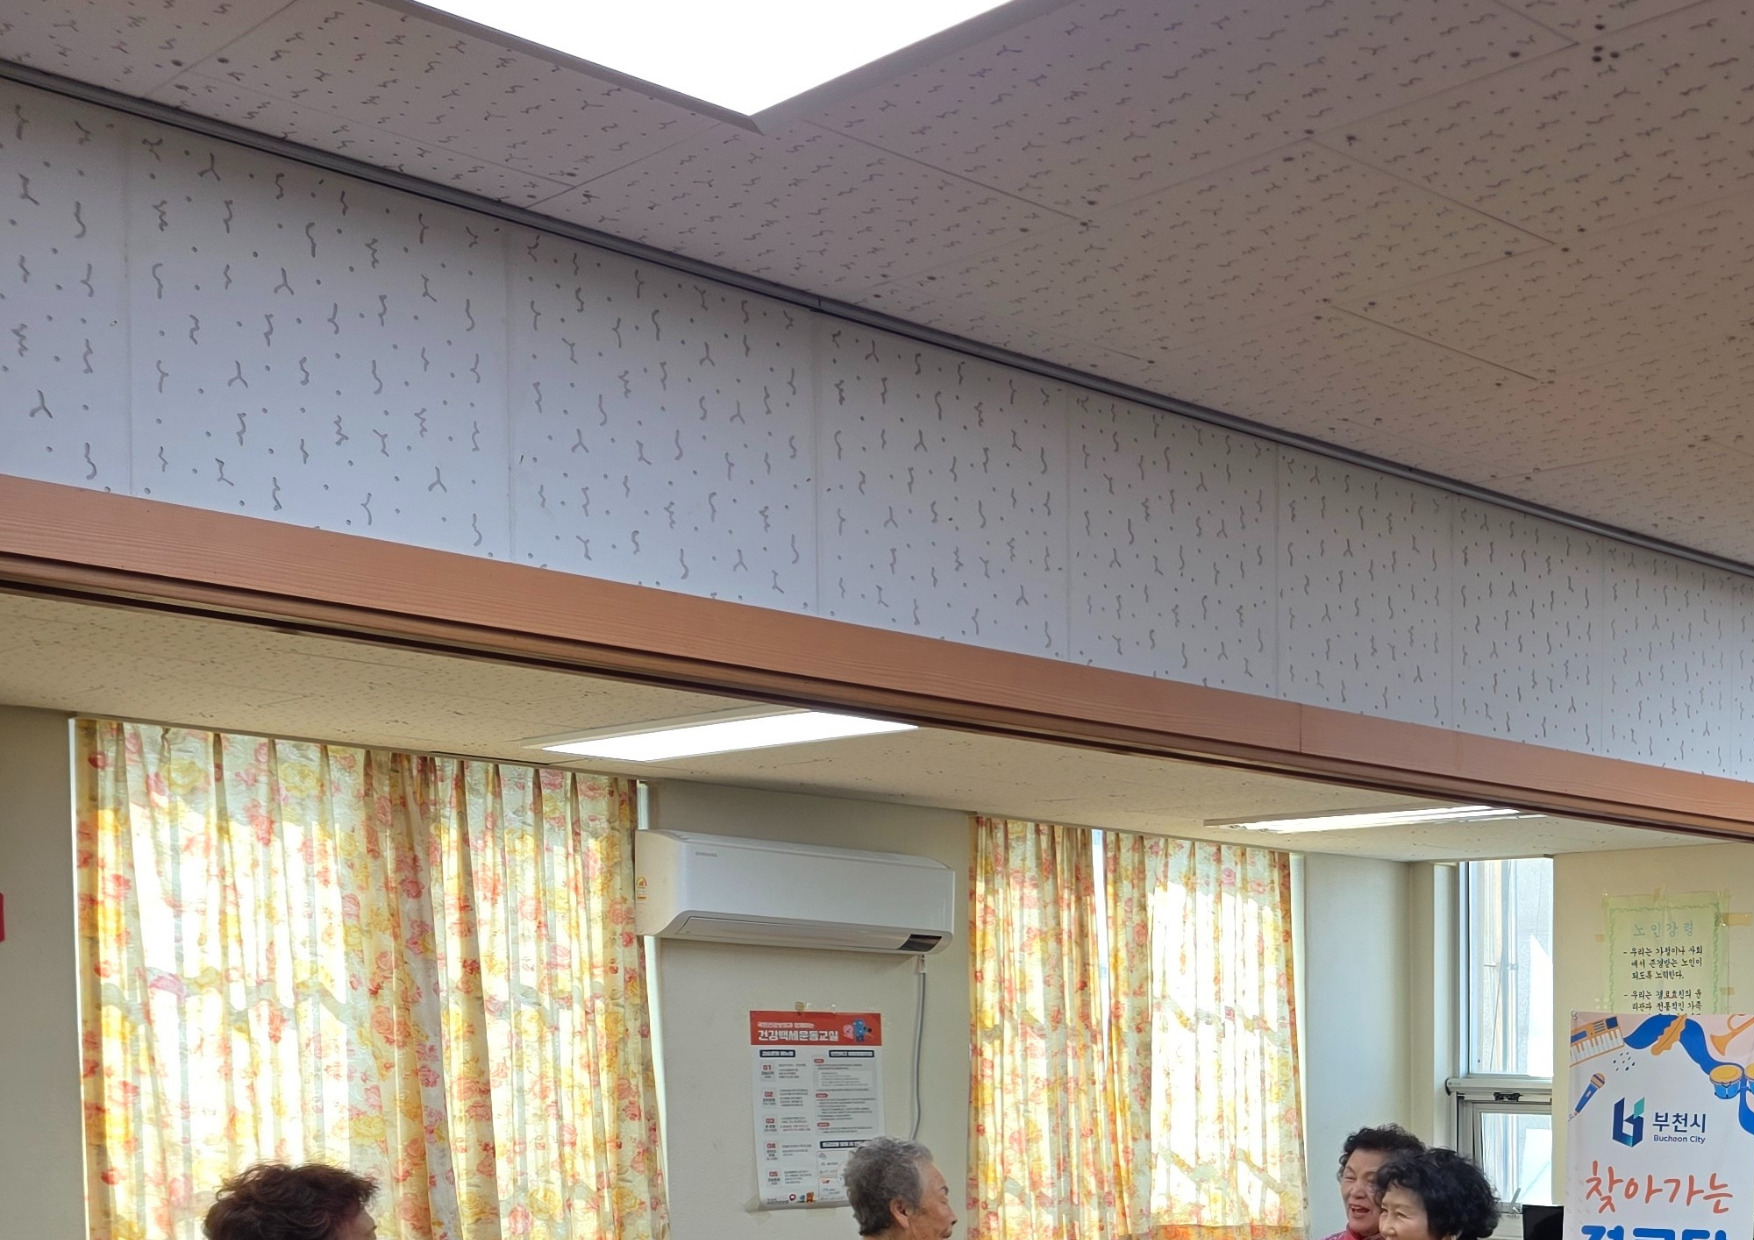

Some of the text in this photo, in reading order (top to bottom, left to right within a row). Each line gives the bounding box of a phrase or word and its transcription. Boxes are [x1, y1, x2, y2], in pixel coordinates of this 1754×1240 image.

[1630, 947, 1652, 957] 우리는
[1689, 945, 1703, 955] 사회
[1631, 959, 1645, 969] 에서
[1681, 957, 1702, 968] 노인이
[1631, 990, 1652, 1000] 우리는
[1652, 1112, 1706, 1133] 부천시
[1653, 1134, 1706, 1144] Bucheon City
[1585, 1160, 1733, 1214] 찾아가는
